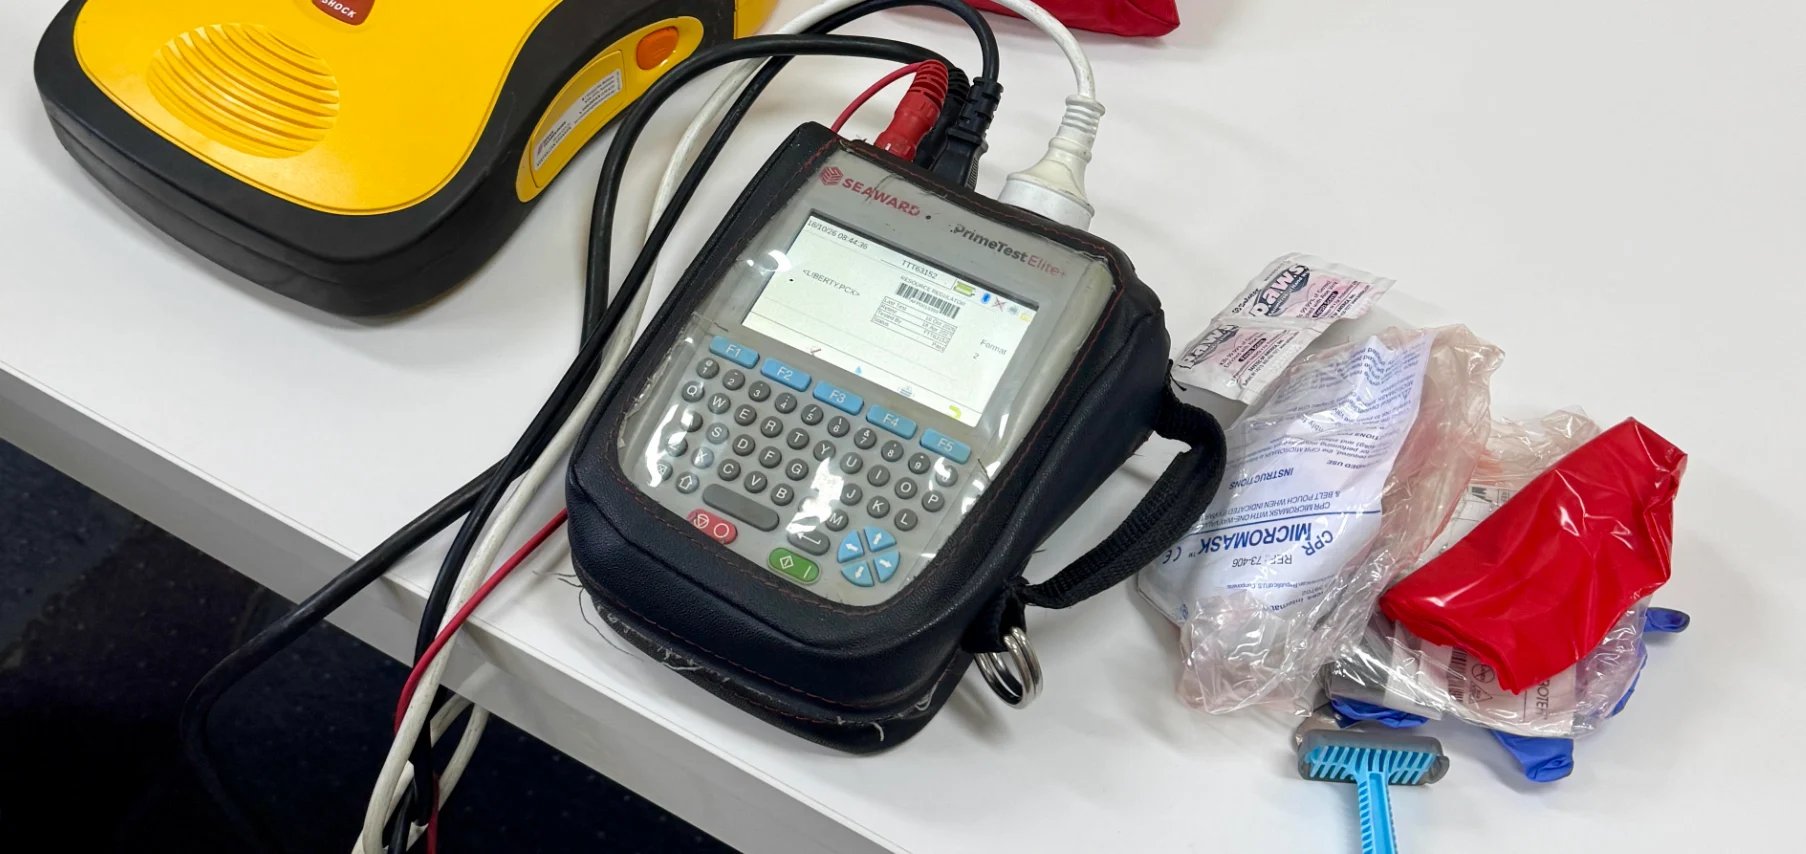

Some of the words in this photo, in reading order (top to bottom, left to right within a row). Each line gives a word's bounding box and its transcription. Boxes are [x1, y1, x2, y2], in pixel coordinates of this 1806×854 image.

[842, 178, 920, 217] SEAWARD
[902, 260, 938, 279] TTT63152
[980, 338, 1007, 356] Format
[725, 343, 741, 358] F1
[776, 366, 794, 381] F2
[828, 389, 847, 404] F3
[883, 413, 900, 427] F4
[936, 436, 953, 452] F5
[727, 378, 735, 387] 2
[753, 389, 761, 398] 3
[780, 401, 788, 410] 4
[806, 413, 814, 421] 5
[833, 424, 840, 433] 6
[887, 449, 894, 458] 8
[914, 461, 922, 470] 9
[686, 385, 698, 397] Q
[712, 396, 727, 408] W
[739, 408, 751, 420] E
[765, 420, 776, 432] R
[794, 431, 804, 443] T
[820, 443, 831, 455] Y
[846, 456, 857, 468] U
[875, 470, 882, 480] I
[900, 481, 912, 493] O
[927, 493, 939, 504] P
[711, 426, 723, 438] S
[737, 438, 749, 450] D
[764, 450, 775, 461] F
[791, 463, 803, 475] G
[846, 489, 857, 500] J
[872, 500, 884, 512] K
[900, 512, 908, 526] L
[1228, 467, 1294, 490] INSTRUCTIONS
[722, 463, 734, 475] C
[751, 474, 761, 486] V
[775, 487, 788, 499] B
[828, 512, 843, 526] M
[1263, 498, 1286, 508] WHEN
[1286, 493, 1311, 504] POUCH
[1314, 490, 1333, 500] BELT
[1249, 511, 1267, 519] WITH
[1269, 504, 1313, 516] MICROMASK
[1314, 501, 1330, 510] CPR
[1301, 530, 1333, 556] CPR
[1232, 555, 1262, 569] 73-406
